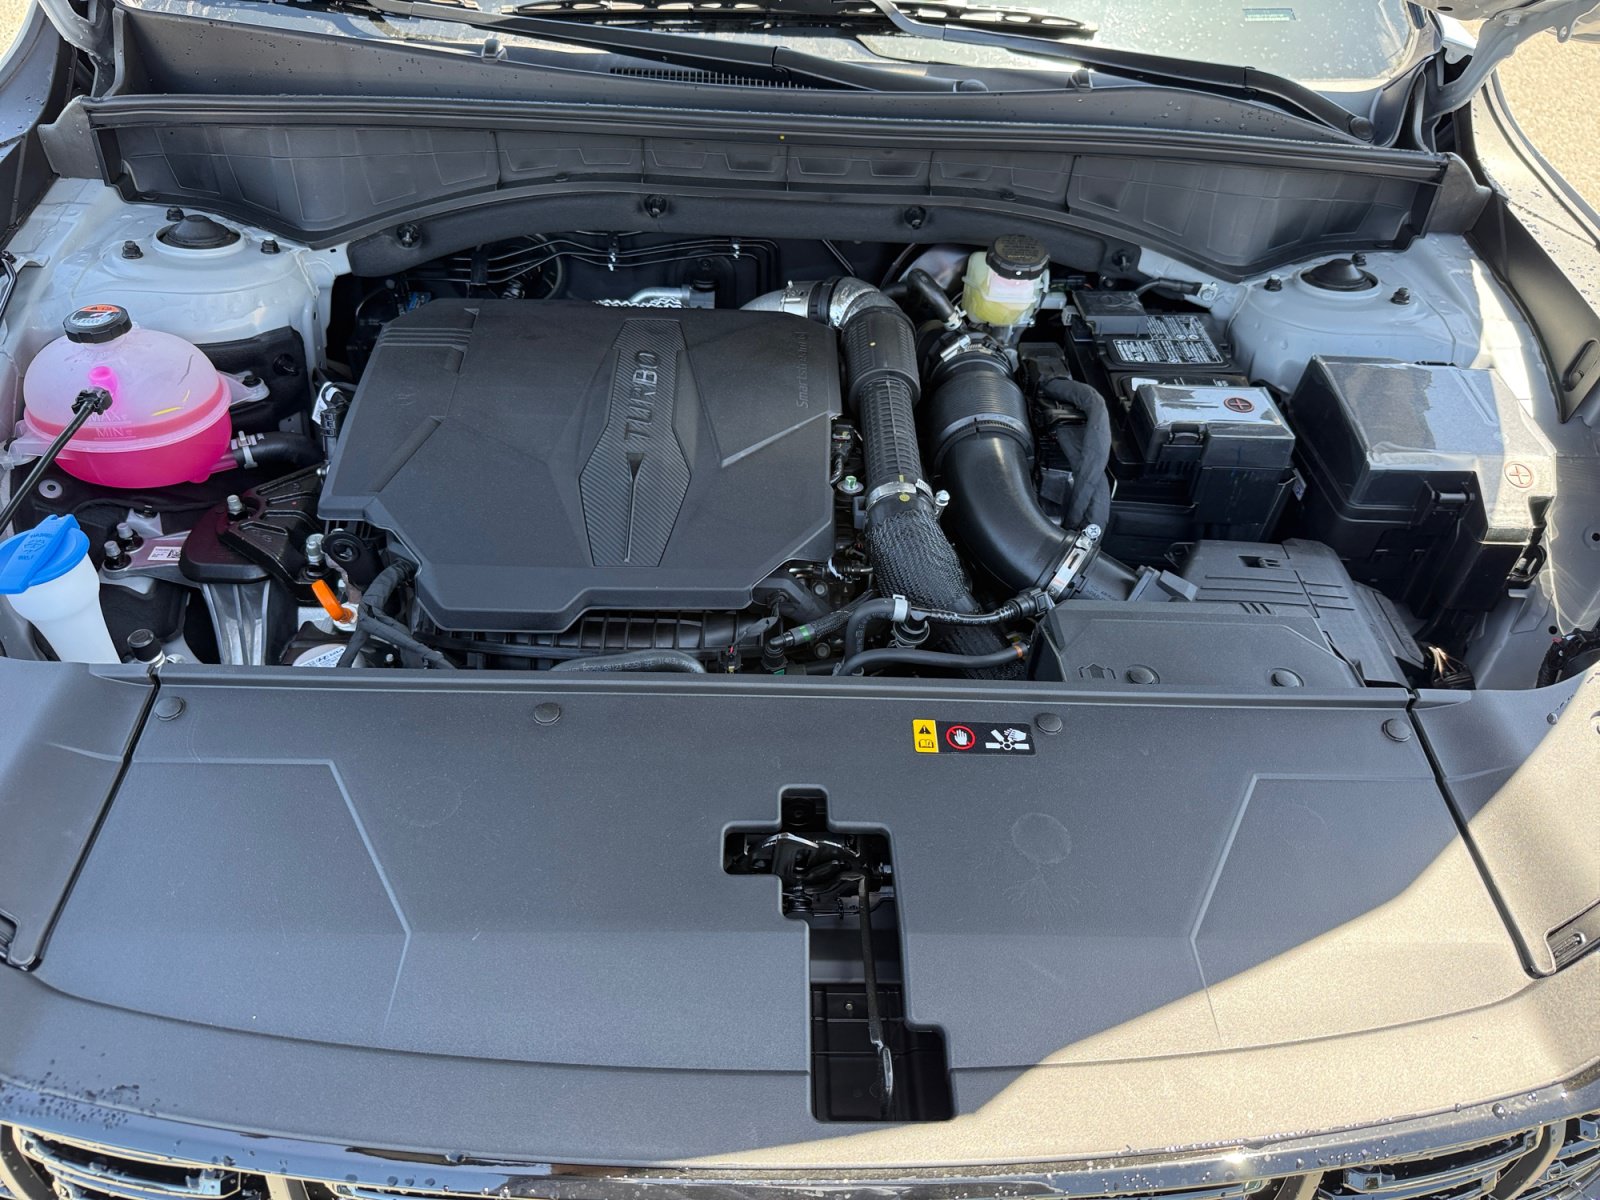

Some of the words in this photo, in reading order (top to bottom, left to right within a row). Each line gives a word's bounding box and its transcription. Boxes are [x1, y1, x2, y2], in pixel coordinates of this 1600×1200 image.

[624, 351, 659, 441] TURBO
[90, 410, 121, 421] MAX
[96, 427, 125, 438] MIN
